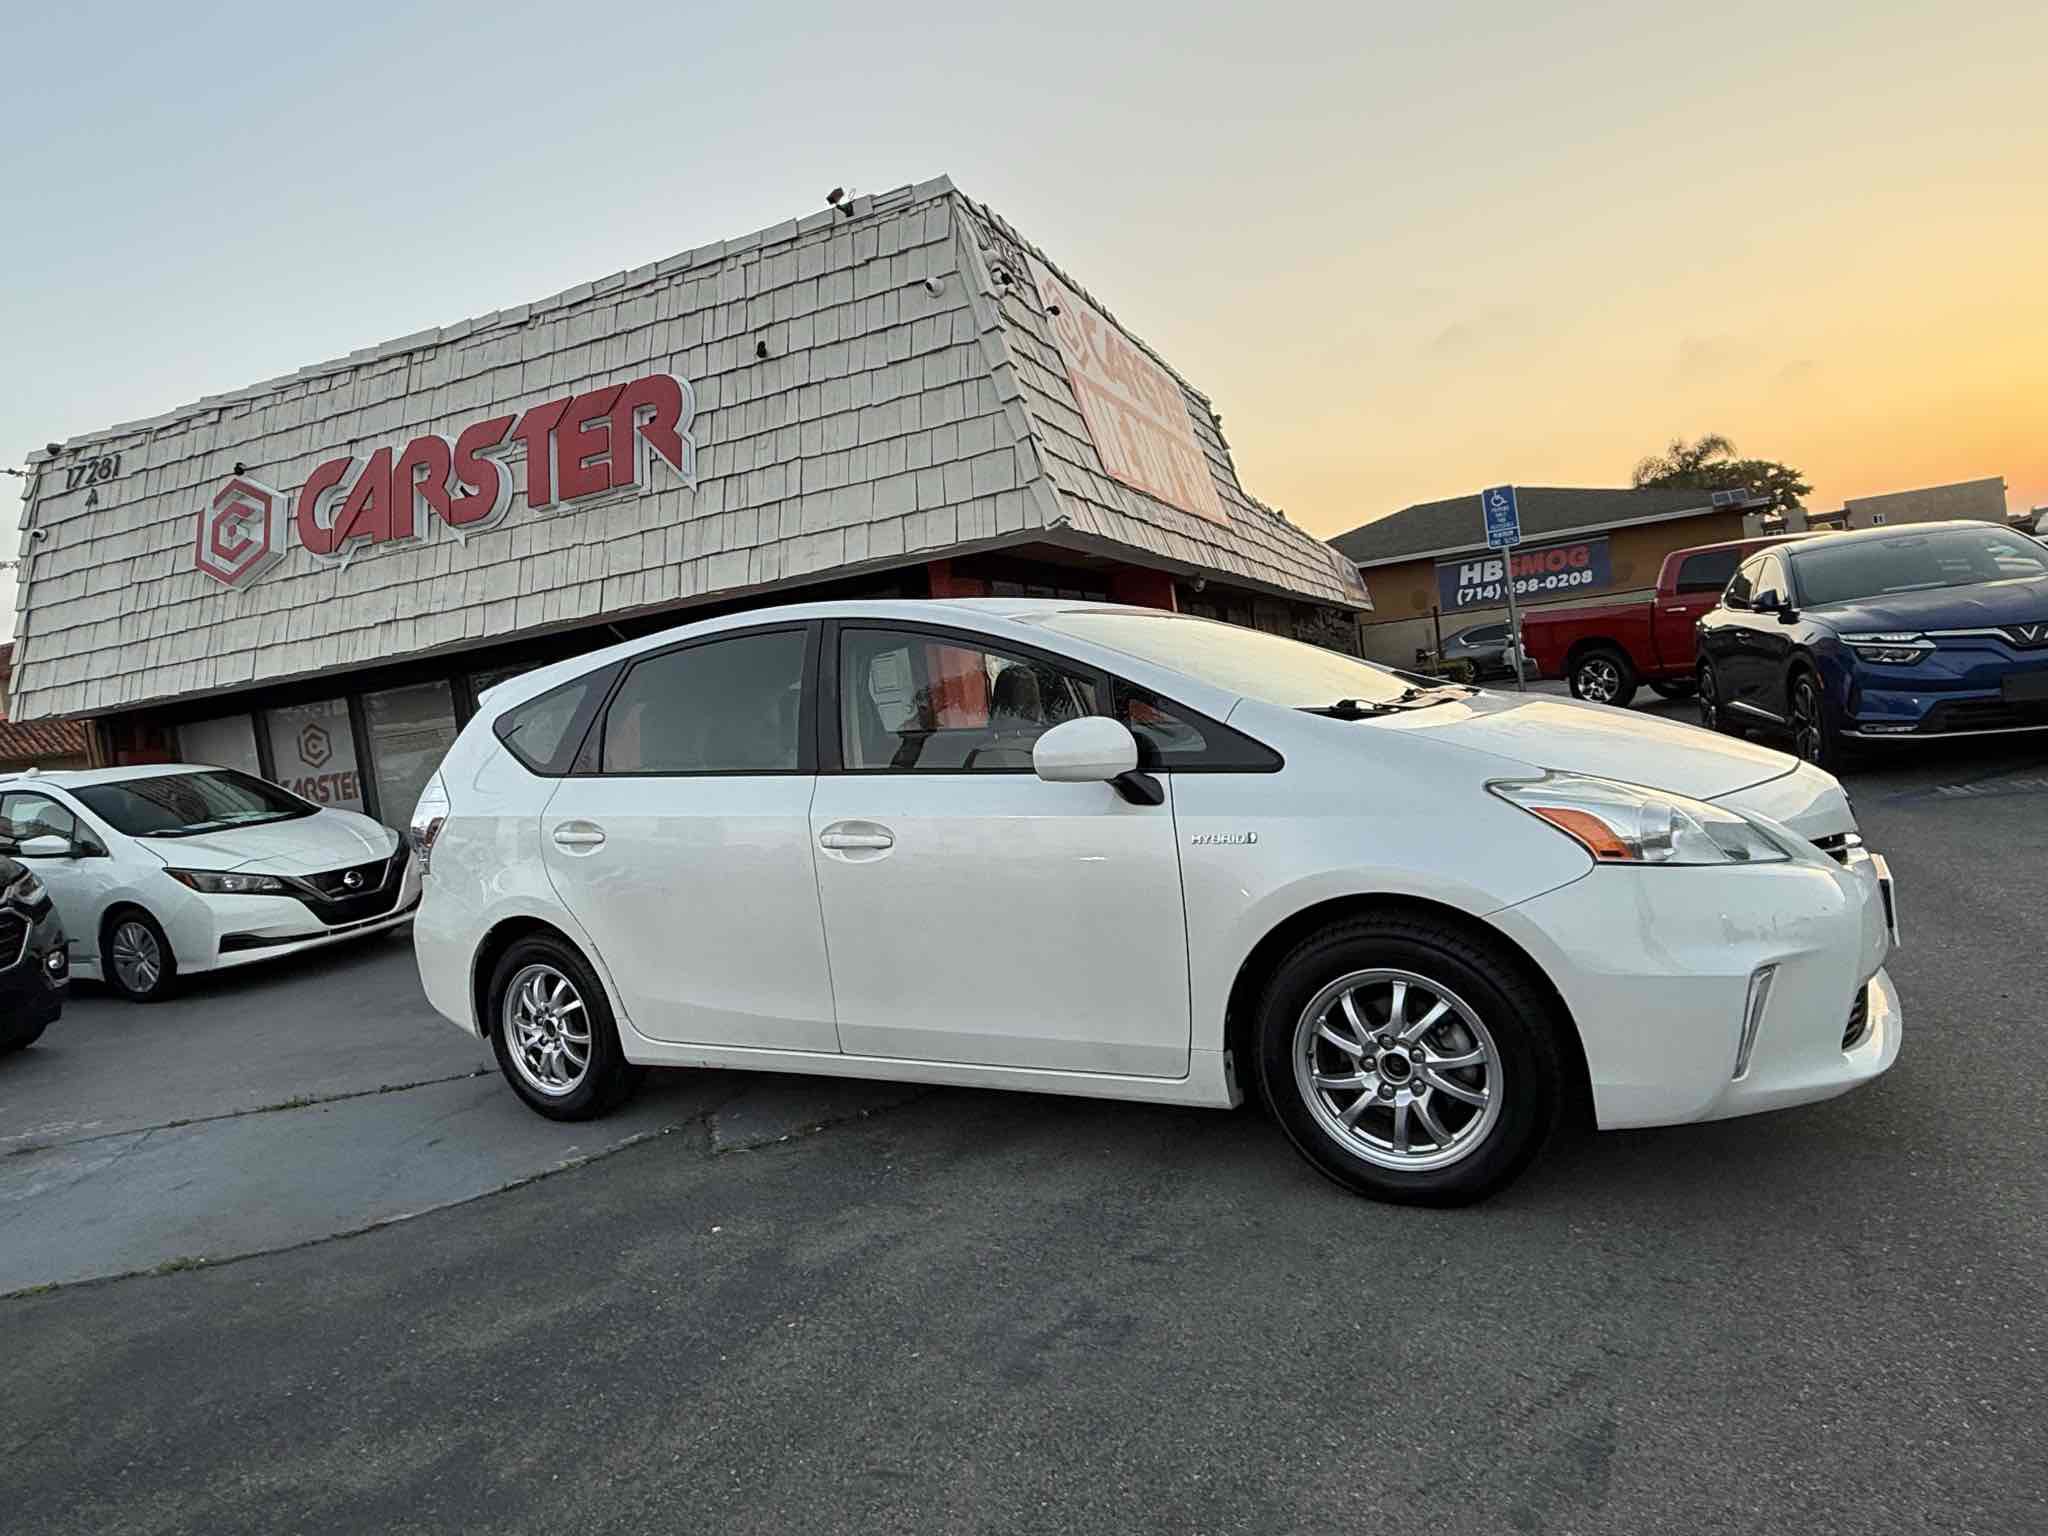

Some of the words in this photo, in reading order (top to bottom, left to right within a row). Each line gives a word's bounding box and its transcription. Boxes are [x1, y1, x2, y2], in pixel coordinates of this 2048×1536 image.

[66, 454, 121, 489] 17281
[297, 374, 690, 560] CARSTER
[1460, 560, 1503, 584] HB
[1457, 584, 1500, 605] (714)
